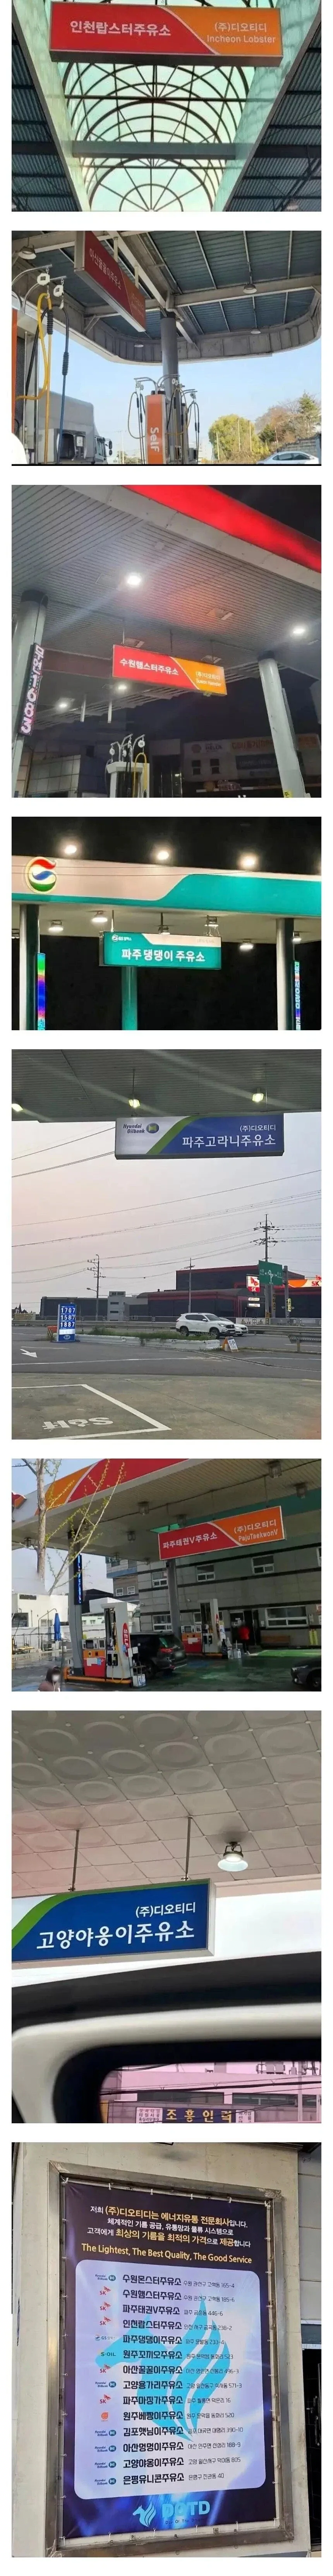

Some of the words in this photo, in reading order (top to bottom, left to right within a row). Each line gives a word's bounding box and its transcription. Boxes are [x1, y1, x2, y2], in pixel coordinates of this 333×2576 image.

[215, 22, 267, 32] (주)디오티디
[207, 35, 240, 43] Incheon
[244, 35, 276, 43] Lobster
[121, 949, 141, 960] 파주
[144, 949, 173, 962] 댕댕이
[175, 951, 206, 962] 주유소
[182, 1134, 276, 1148] 파주고라니주유소
[234, 1519, 276, 1534] (주)디오티디
[163, 1532, 218, 1549] 파주태권V주유소
[136, 1902, 196, 1918] (주)디오티디
[36, 1920, 194, 1949] 고양야옹이주유소
[105, 2205, 159, 2219] (주)디오티디는
[161, 2212, 199, 2224] 에너지유통
[201, 2216, 247, 2228] 전문회사입니다.
[107, 2218, 133, 2226] 체계적인
[149, 2222, 164, 2230] 공급,
[165, 2224, 190, 2232] 유통망과
[87, 2227, 114, 2236] 고객에게
[116, 2229, 139, 2239] 최상의
[142, 2231, 165, 2241] 기름을
[167, 2233, 190, 2243] 최적의
[192, 2236, 218, 2245] 가격으로
[220, 2238, 251, 2248] 제공합니다
[81, 2243, 96, 2252] The
[98, 2245, 130, 2256] Lightest,
[148, 2249, 163, 2257] Best
[165, 2250, 192, 2260] Quality,
[193, 2252, 206, 2260] The
[208, 2254, 227, 2262] Good
[229, 2255, 252, 2264] Service
[123, 2274, 182, 2286] 수원몬스터주유소
[123, 2290, 182, 2300] 수원햄스터주유소
[122, 2305, 180, 2315] 파주태권V주유소
[123, 2335, 182, 2344] 파주댕댕이주유소
[123, 2350, 182, 2359] 원주꼬끼오주유소
[123, 2366, 182, 2374] 아산꿀꿀이주유소
[123, 2381, 183, 2389] 고양용가리주유소
[123, 2396, 183, 2405] 파주마징가주유소
[123, 2411, 183, 2421] 원주베짱이주유소
[123, 2426, 184, 2436] 김포햇님이주유소
[123, 2442, 184, 2452] 아산멍멍이주유소
[123, 2457, 184, 2468] 고양야옹이주유소
[123, 2473, 184, 2485] 은평유니콘주유소
[162, 2500, 210, 2518] DOTD
